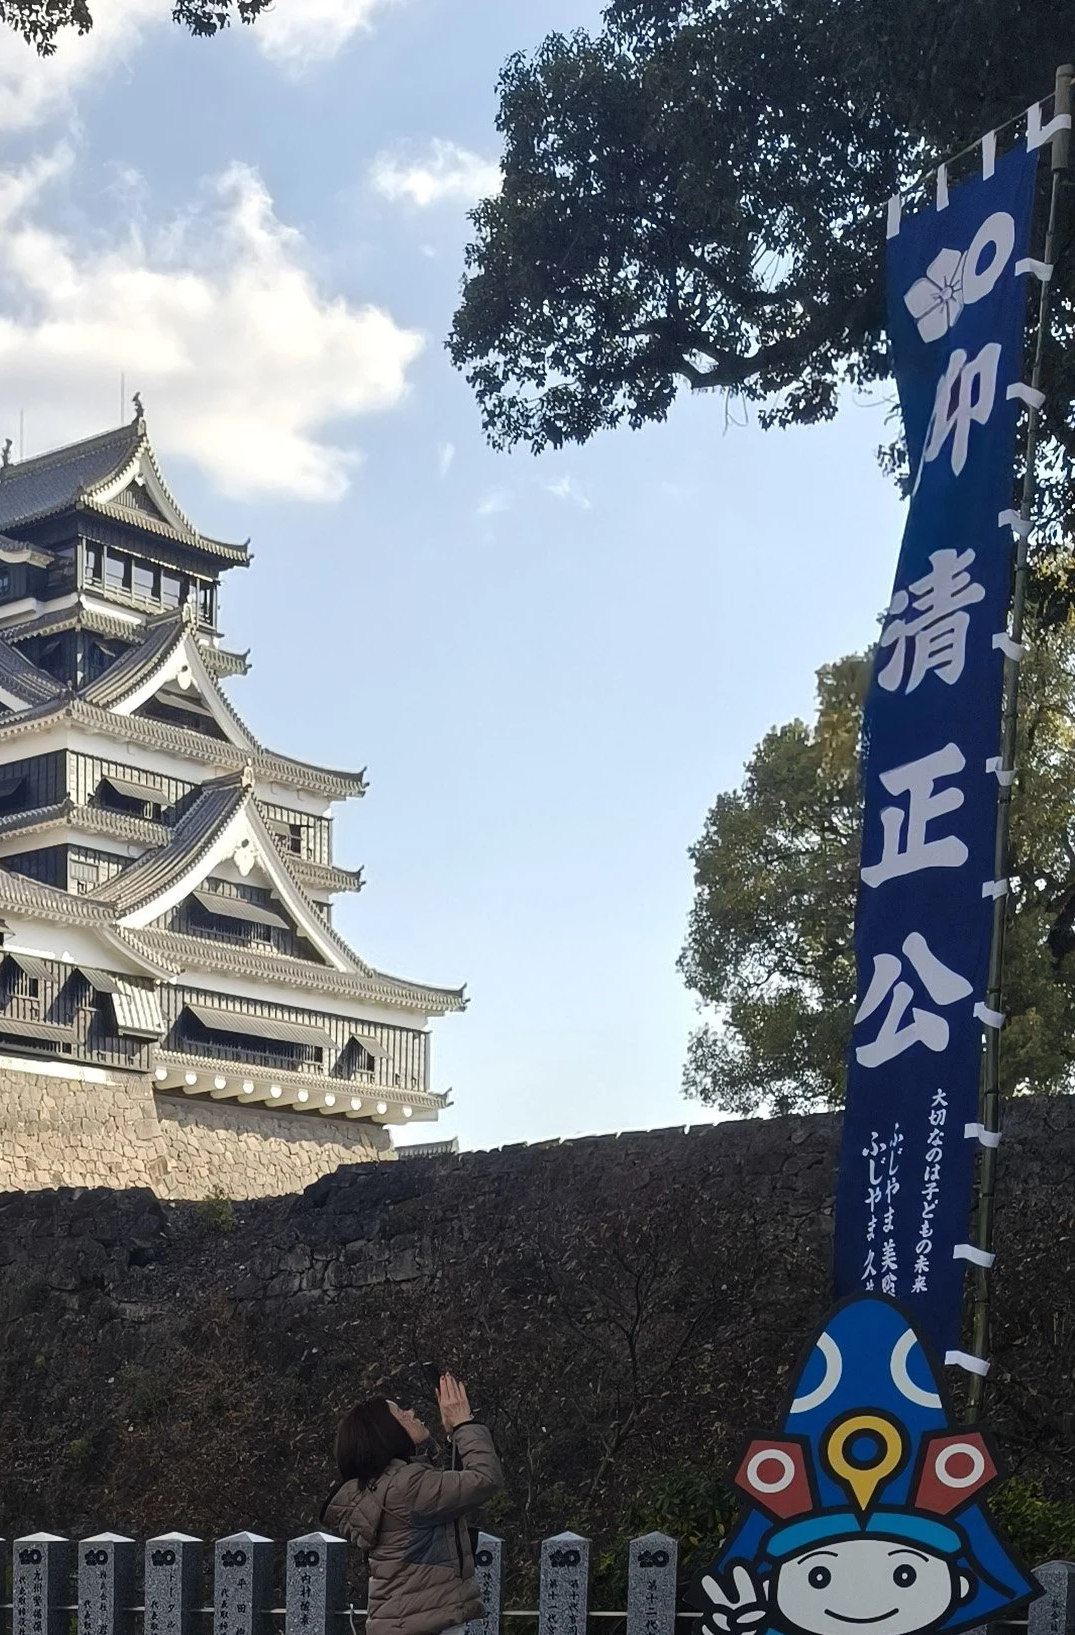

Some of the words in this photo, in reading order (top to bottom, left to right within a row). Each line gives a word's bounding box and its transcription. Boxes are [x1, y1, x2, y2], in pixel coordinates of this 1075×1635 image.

[911, 1088, 948, 1293] 大切なのは子どもの未来
